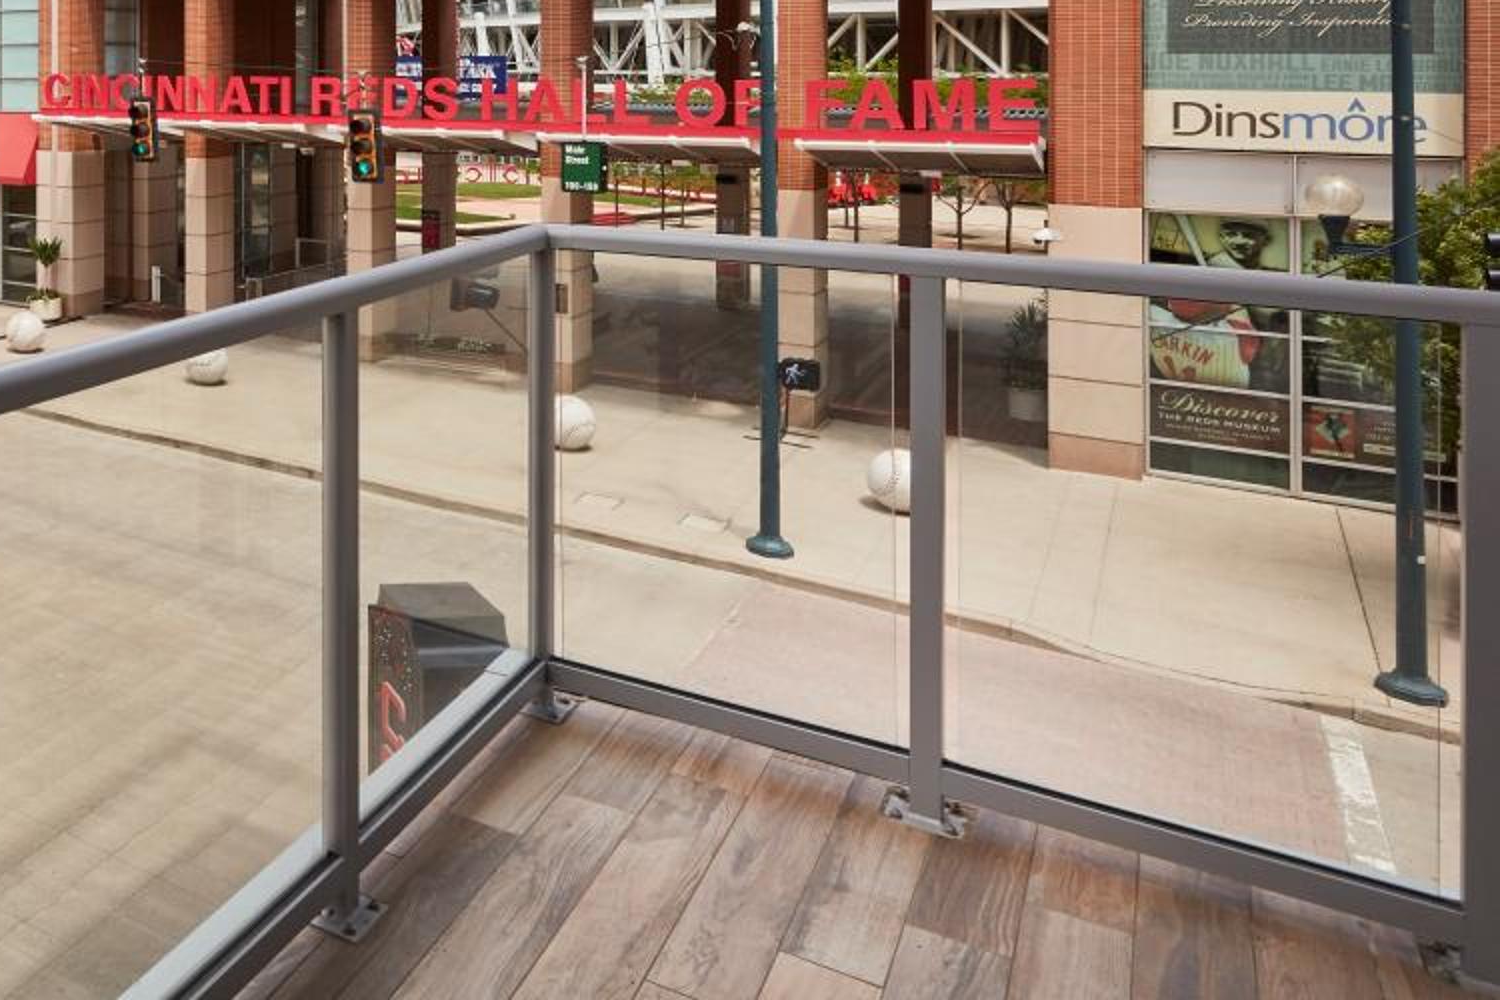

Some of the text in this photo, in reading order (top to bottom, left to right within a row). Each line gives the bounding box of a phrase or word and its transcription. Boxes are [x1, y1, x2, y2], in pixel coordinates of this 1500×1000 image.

[43, 72, 1040, 132] CINCINNATI REDS HALL OF FAME
[1158, 388, 1280, 424] Discover
